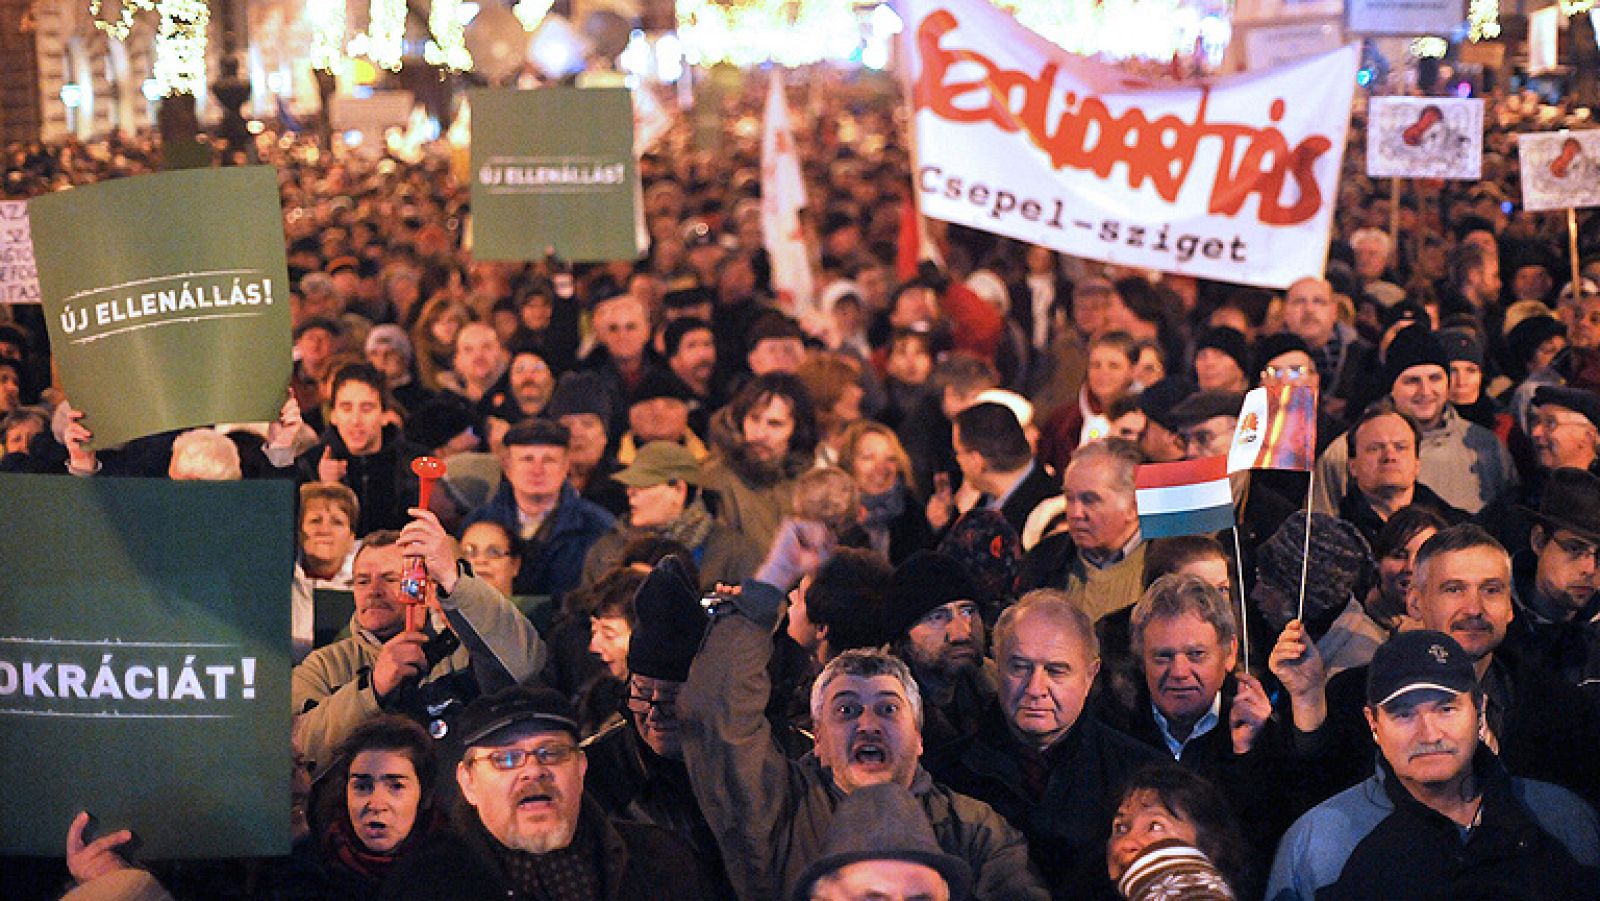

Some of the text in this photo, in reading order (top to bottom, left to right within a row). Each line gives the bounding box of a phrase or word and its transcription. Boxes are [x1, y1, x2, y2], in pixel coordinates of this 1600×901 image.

[479, 163, 624, 185] ÚJ ELLENÁLLÁS!
[920, 165, 1248, 262] Csepel-sziget
[60, 277, 273, 334] ÚJ ELLENÁLLÁS!
[0, 654, 257, 700] OKRÁCIÁT!
